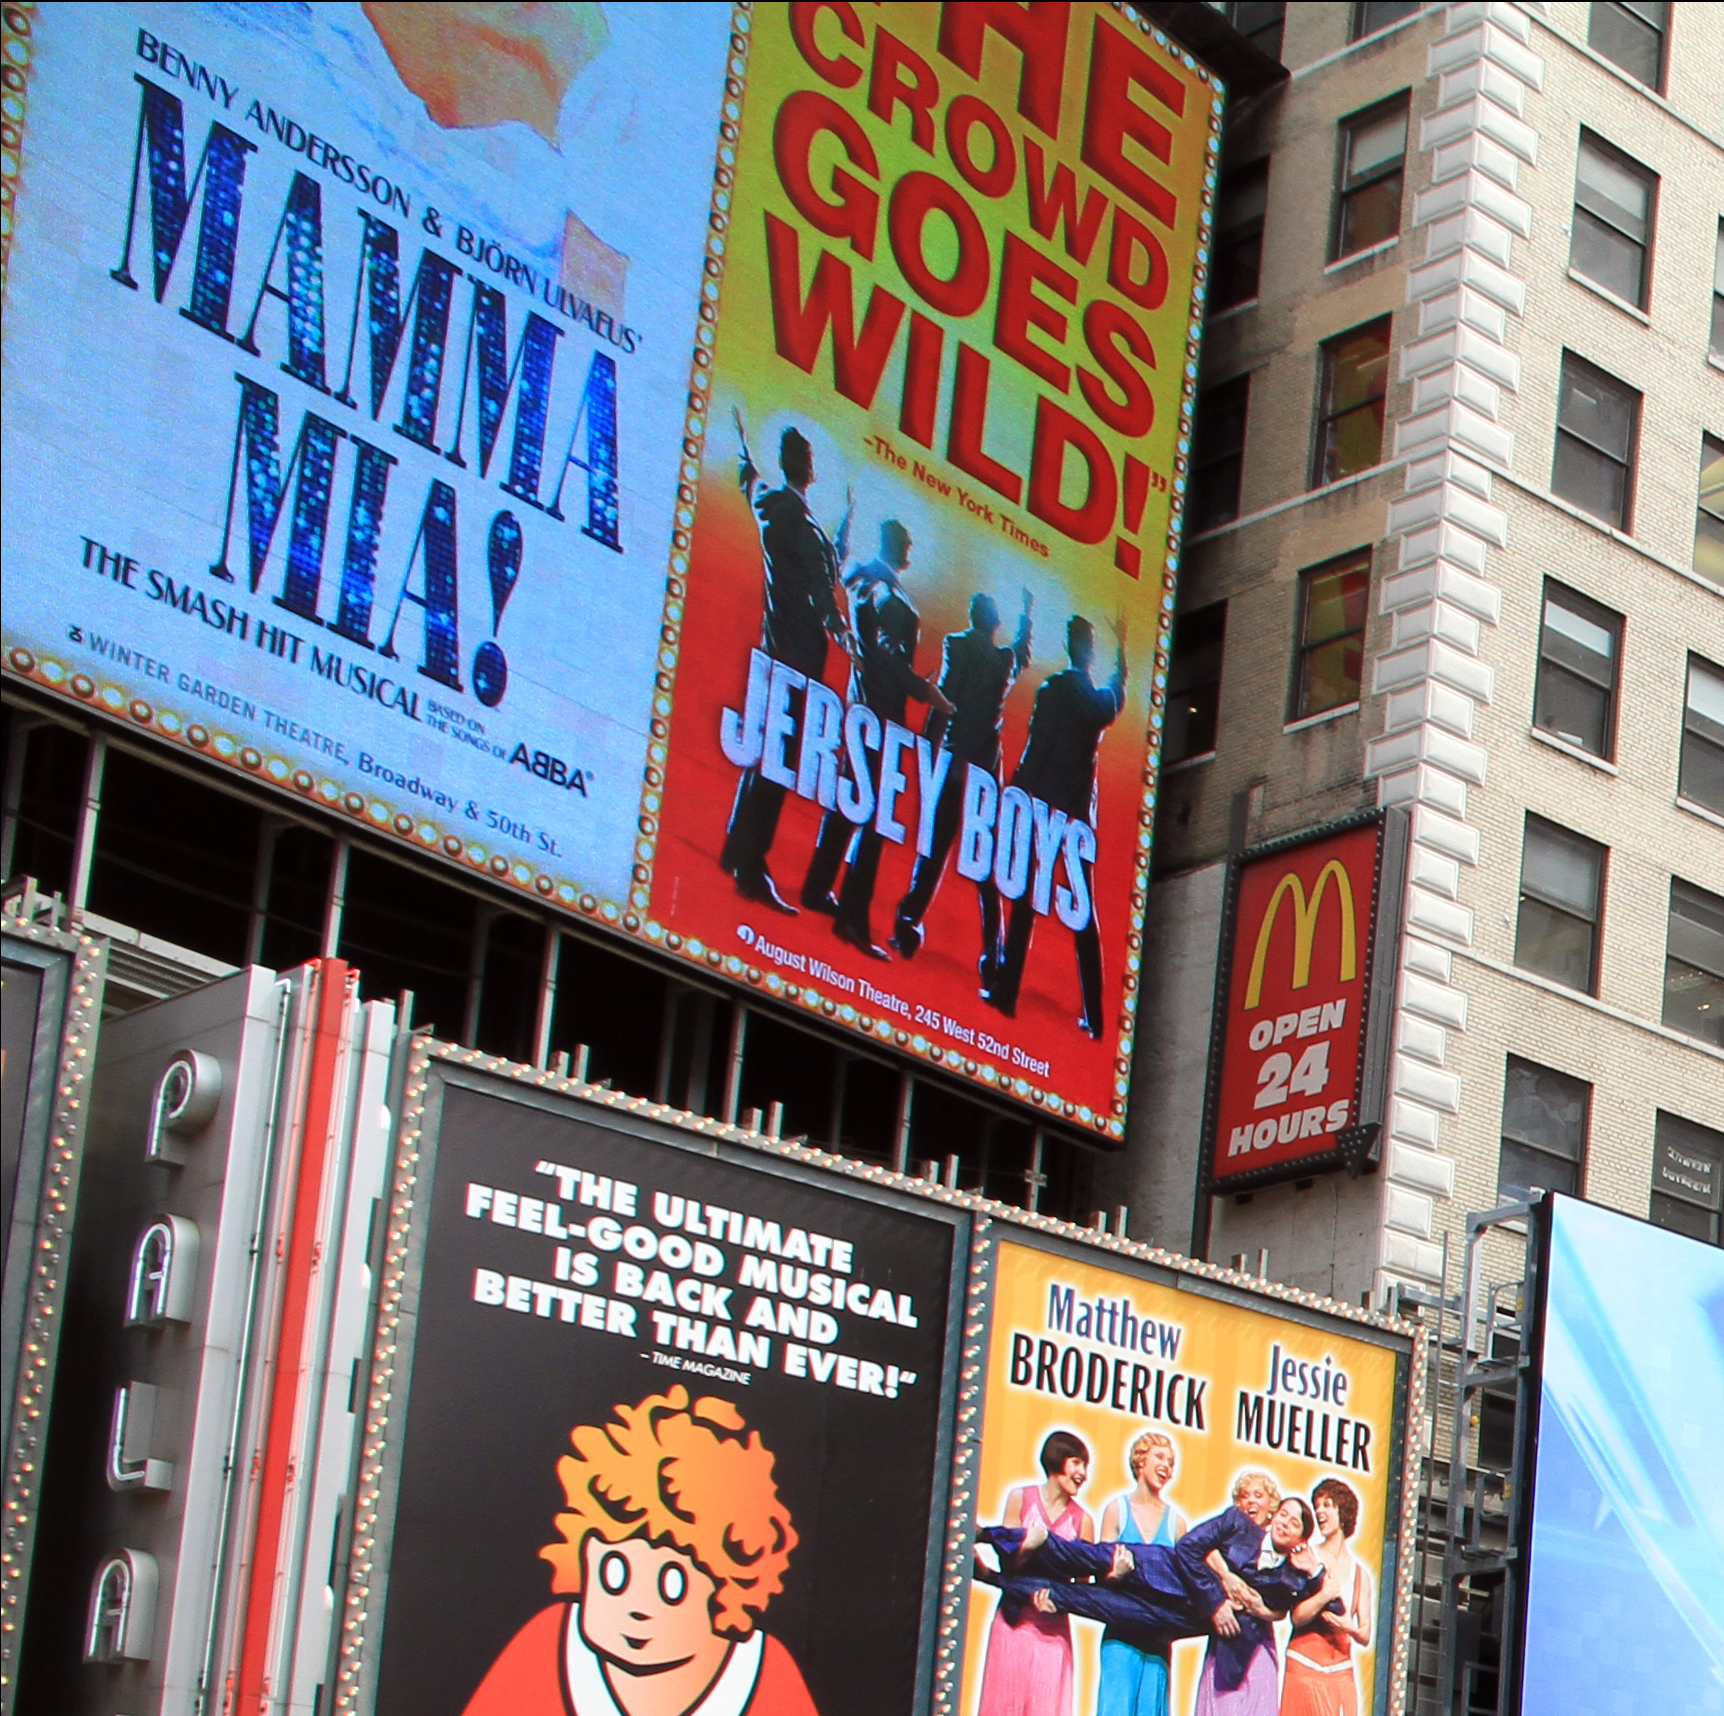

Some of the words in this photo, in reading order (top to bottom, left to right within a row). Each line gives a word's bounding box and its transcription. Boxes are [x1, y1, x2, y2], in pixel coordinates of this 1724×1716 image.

[788, 0, 1169, 310] CROWD
[110, 72, 624, 554] MAMMA
[773, 89, 1157, 438] GOES
[210, 371, 524, 709] MIA!
[912, 459, 954, 494] New
[956, 482, 994, 524] York
[1000, 508, 1051, 558] Times
[80, 535, 138, 589] THE
[144, 569, 250, 642] SMASH
[257, 618, 305, 665] HIT
[311, 644, 423, 722] MUSICAL
[719, 647, 953, 859] JERSEY
[956, 762, 1097, 931] BOYS
[1249, 998, 1346, 1051] OPEN
[1253, 1041, 1331, 1110] 24
[1228, 1099, 1349, 1158] HOURS
[464, 1182, 726, 1277] FEEL-GOOD
[738, 1256, 918, 1328] MUSICAL
[553, 1246, 599, 1286] IS
[614, 1261, 733, 1322] BACK
[744, 1298, 838, 1345] AND
[1048, 1283, 1181, 1361] Matthew
[1011, 1333, 1207, 1430] BRODERICK
[1267, 1344, 1347, 1406] Jessie
[1237, 1391, 1371, 1472] MUELLER
